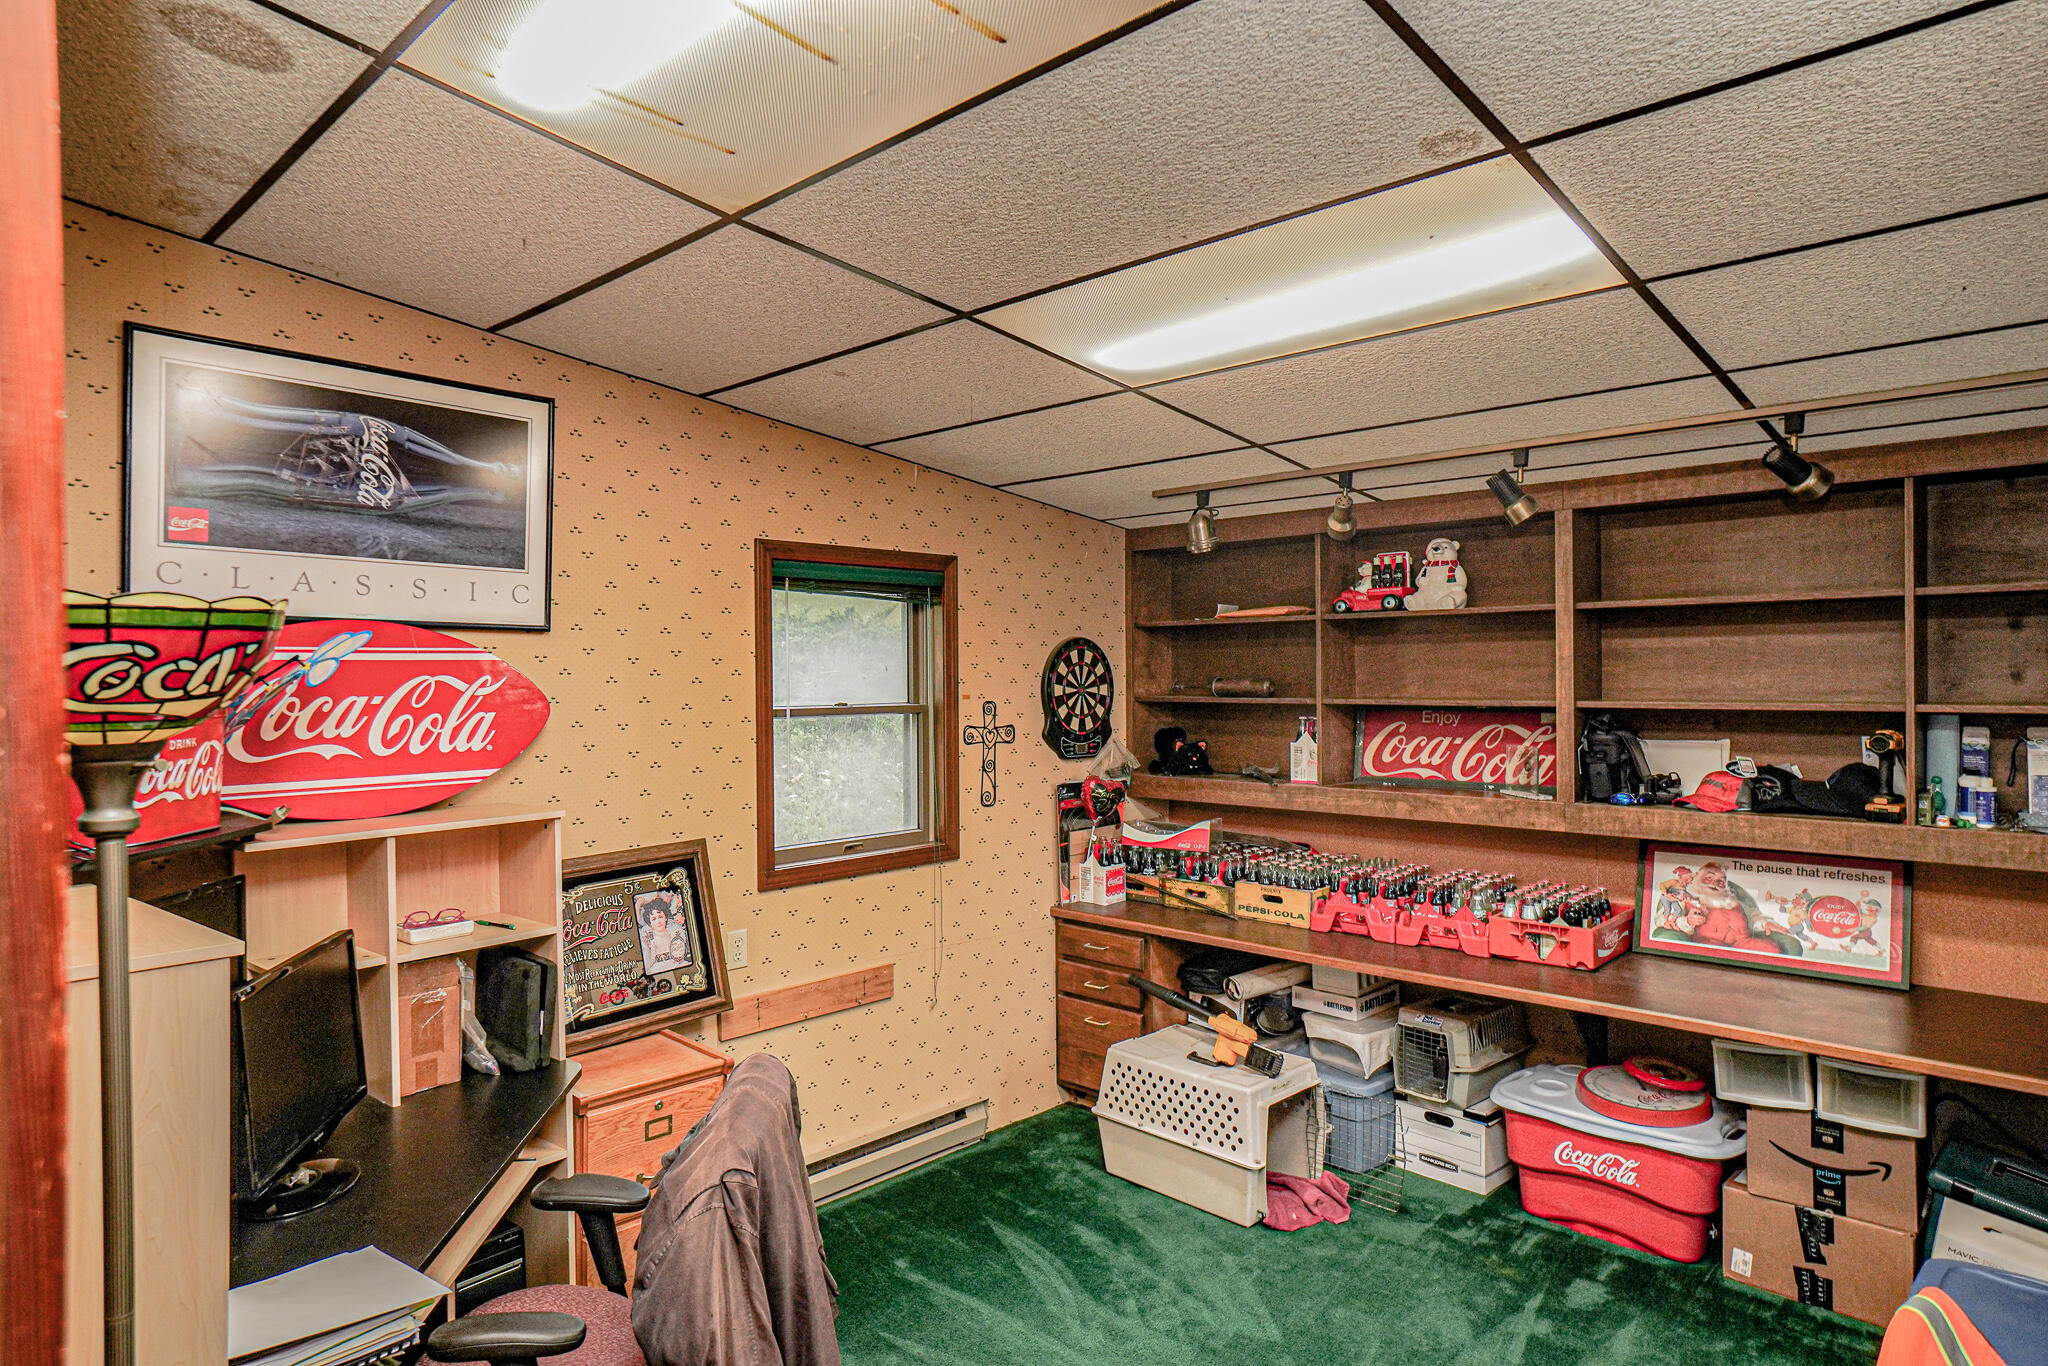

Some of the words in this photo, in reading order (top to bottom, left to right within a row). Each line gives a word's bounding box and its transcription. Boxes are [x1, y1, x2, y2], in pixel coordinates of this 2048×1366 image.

[357, 416, 396, 510] Coca-Cola
[225, 675, 508, 763] Coca-Cola
[1422, 711, 1461, 726] Enjoy
[169, 738, 198, 750] DRINK
[1363, 721, 1556, 784] Coca-Cola
[1732, 860, 1754, 873] The
[1756, 864, 1792, 877] pause
[1796, 866, 1821, 879] that
[1823, 869, 1886, 884] refreshes
[575, 893, 624, 915] DELICIOUS
[1813, 909, 1857, 925] Coca-Cola
[564, 948, 598, 967] ELIEVES
[600, 938, 634, 960] FATIGUE
[568, 971, 584, 984] MOST
[578, 983, 588, 993] IN
[589, 978, 604, 990] THE
[1326, 1001, 1354, 1013] BATTLESHIP
[1421, 1155, 1445, 1167] BANKERS
[1445, 1163, 1458, 1171] BOX
[1554, 1141, 1640, 1188] Coca-Cola
[1815, 1169, 1841, 1180] prime
[1947, 1245, 1979, 1262] MAVIC
